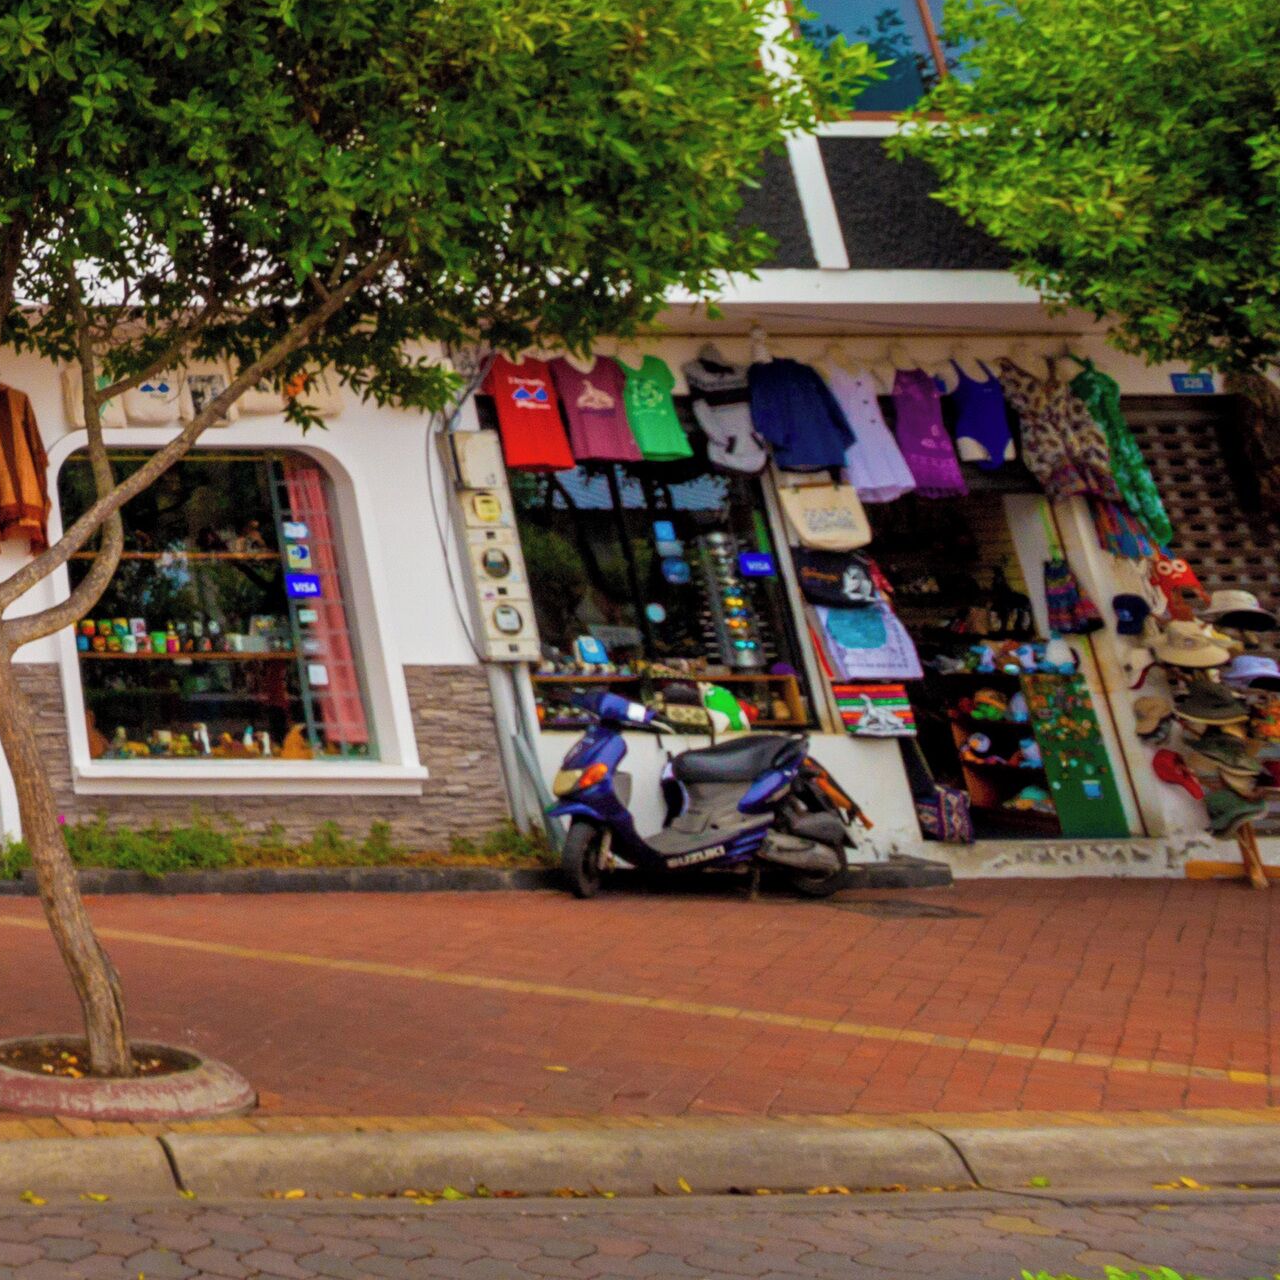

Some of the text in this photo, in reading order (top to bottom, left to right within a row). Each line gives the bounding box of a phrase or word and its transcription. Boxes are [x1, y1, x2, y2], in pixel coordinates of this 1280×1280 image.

[746, 560, 771, 570] VISA
[292, 582, 318, 593] VISA
[666, 844, 726, 868] SUZUKI
